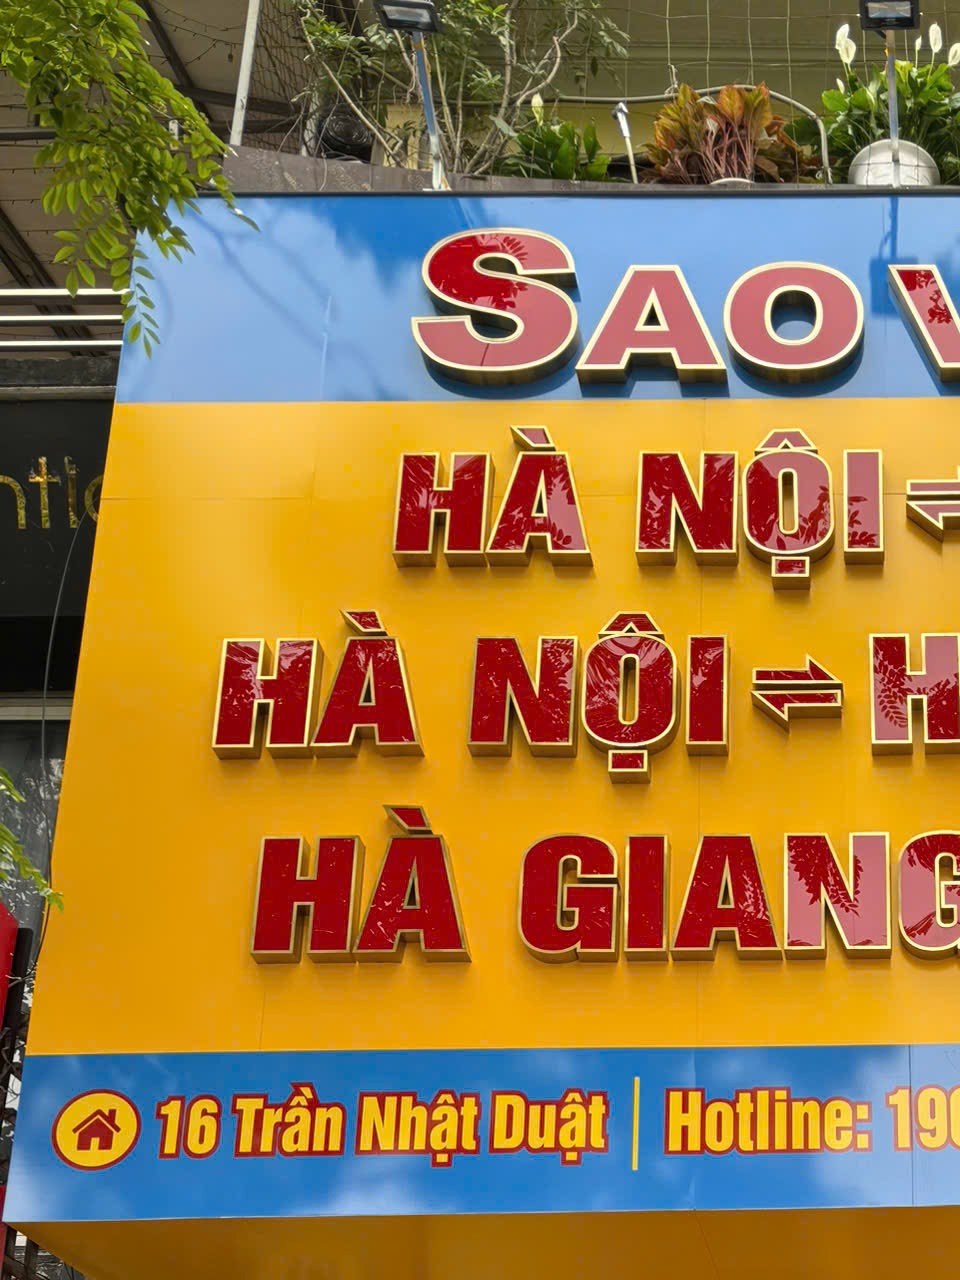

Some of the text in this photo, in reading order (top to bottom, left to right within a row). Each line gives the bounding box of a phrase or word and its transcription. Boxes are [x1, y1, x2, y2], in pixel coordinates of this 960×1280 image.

[394, 425, 593, 567] HÀ
[636, 428, 884, 590] NỘI
[212, 610, 425, 759] HÀ
[468, 611, 729, 784] NỘI
[250, 804, 471, 964] HÀ
[155, 1090, 219, 1160] 16
[232, 1082, 345, 1159] Trần
[355, 1090, 480, 1167] Nhật
[490, 1089, 609, 1167] Duật
[664, 1086, 873, 1157] Hotline:
